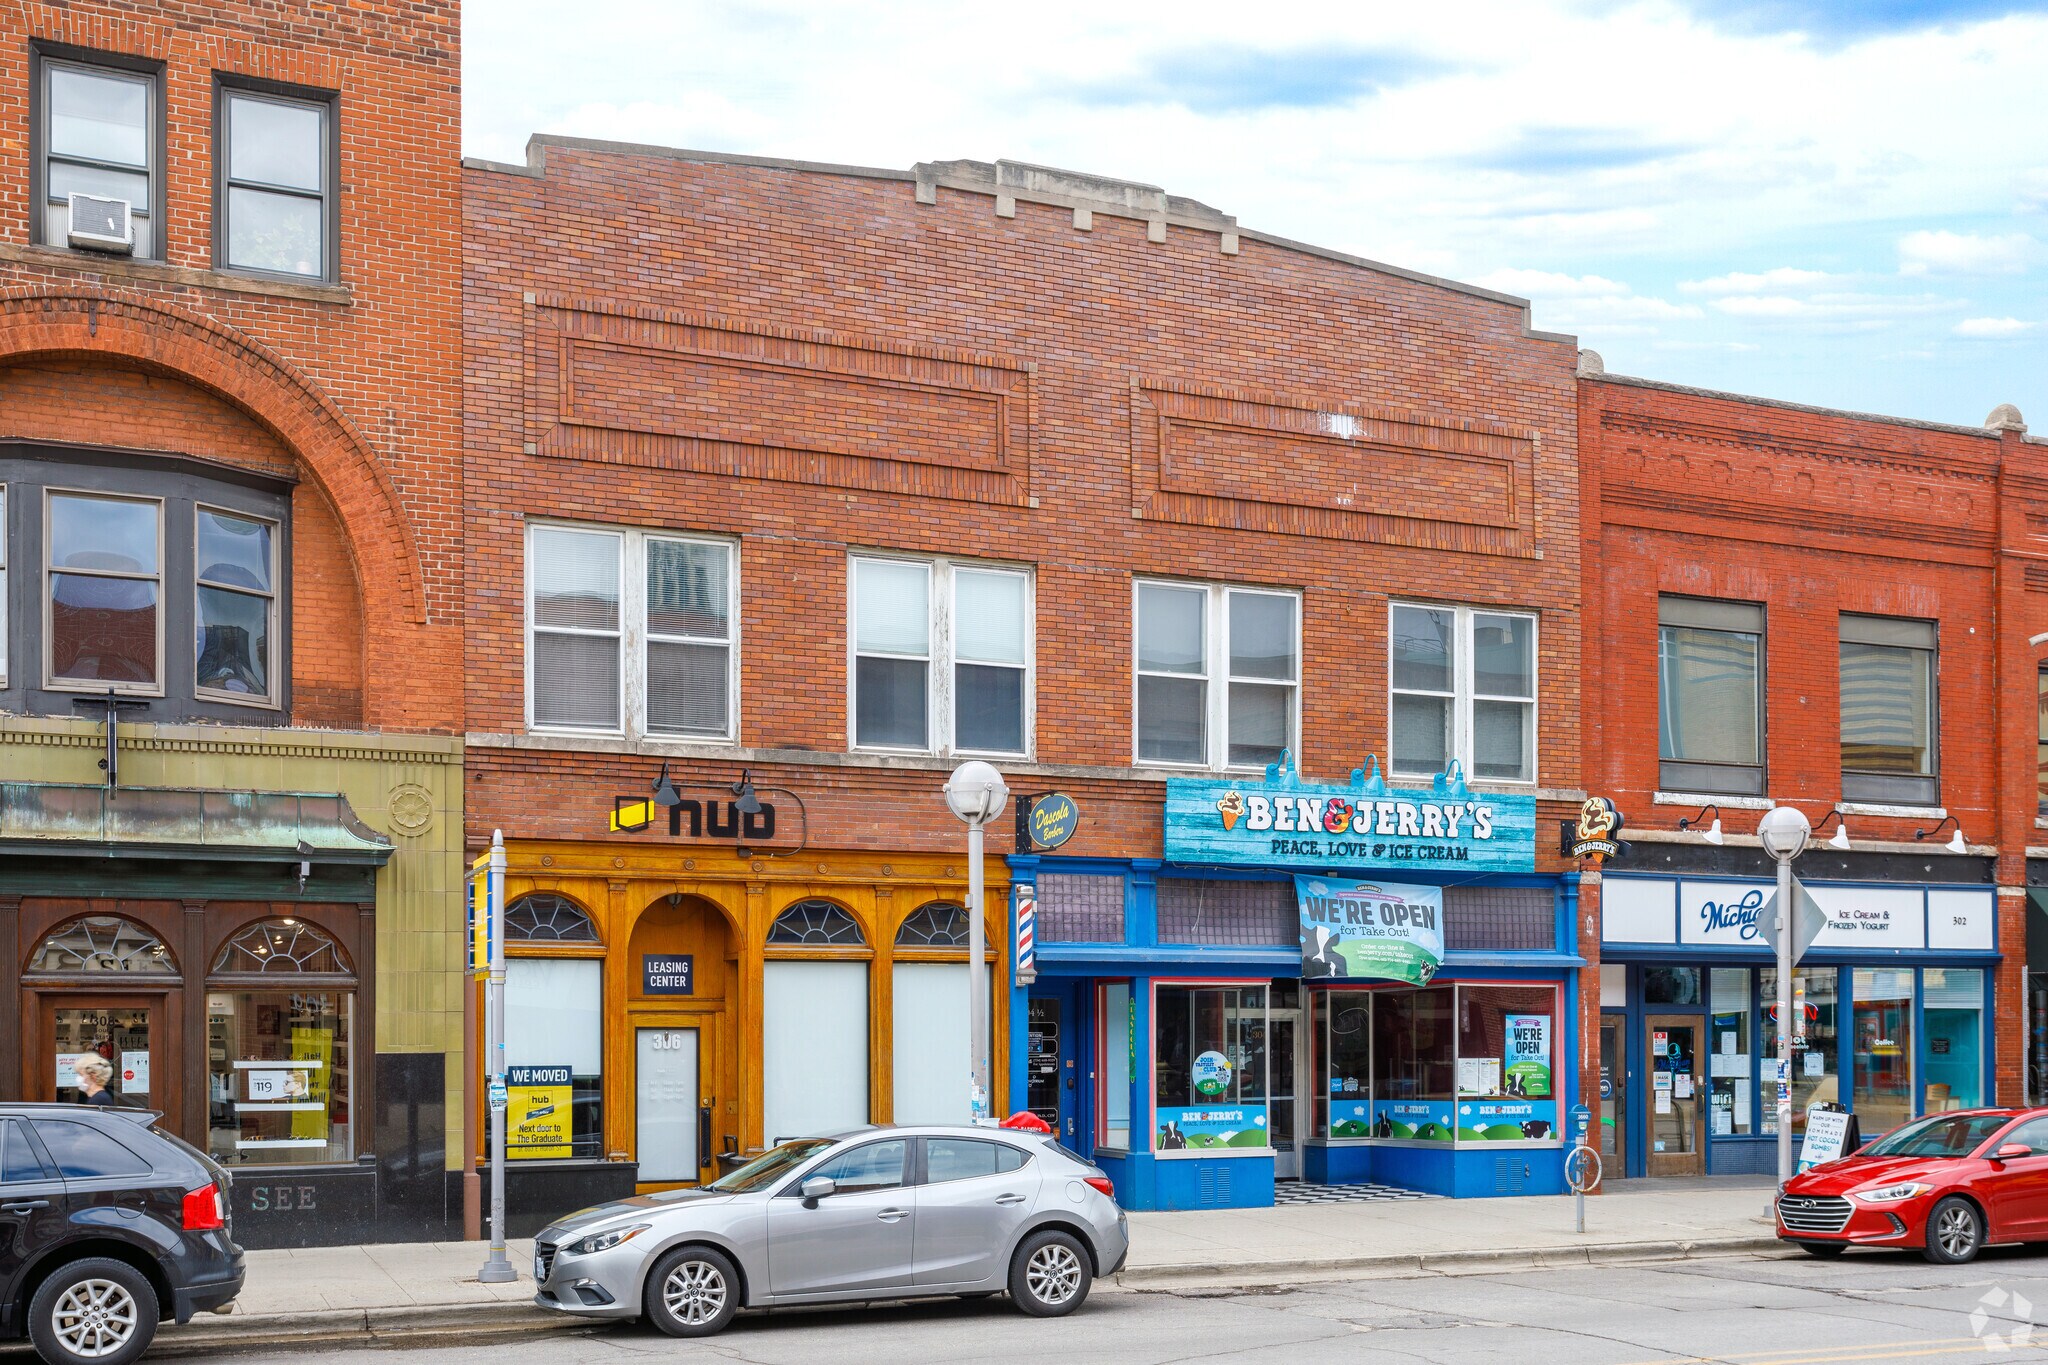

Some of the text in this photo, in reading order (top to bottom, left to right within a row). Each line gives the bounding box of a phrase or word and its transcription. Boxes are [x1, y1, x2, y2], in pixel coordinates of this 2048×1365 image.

[669, 788, 775, 839] hub
[1035, 801, 1069, 830] Dascola
[1043, 824, 1064, 841] Barbers
[1271, 839, 1469, 861] PEACE, LOVE & ICE CREAM
[1305, 896, 1436, 931] WE'RE OPEN
[1700, 889, 1764, 940] Michig
[1883, 911, 1890, 920] &
[1952, 916, 1967, 926] 302
[1340, 925, 1410, 937] for Take Out!
[648, 961, 689, 974] LEASING
[650, 975, 687, 988] CENTER
[1513, 1027, 1543, 1041] WE'RE
[653, 1034, 681, 1050] 306
[1516, 1041, 1540, 1054] OPEN
[512, 1069, 568, 1082] WE MOVED
[531, 1095, 549, 1104] hub
[518, 1124, 561, 1133] Next door to
[1808, 1128, 1843, 1137] HOMEMADE
[517, 1134, 563, 1143] The Graduate
[1819, 1137, 1840, 1145] COCOA
[251, 1185, 317, 1212] SEE
